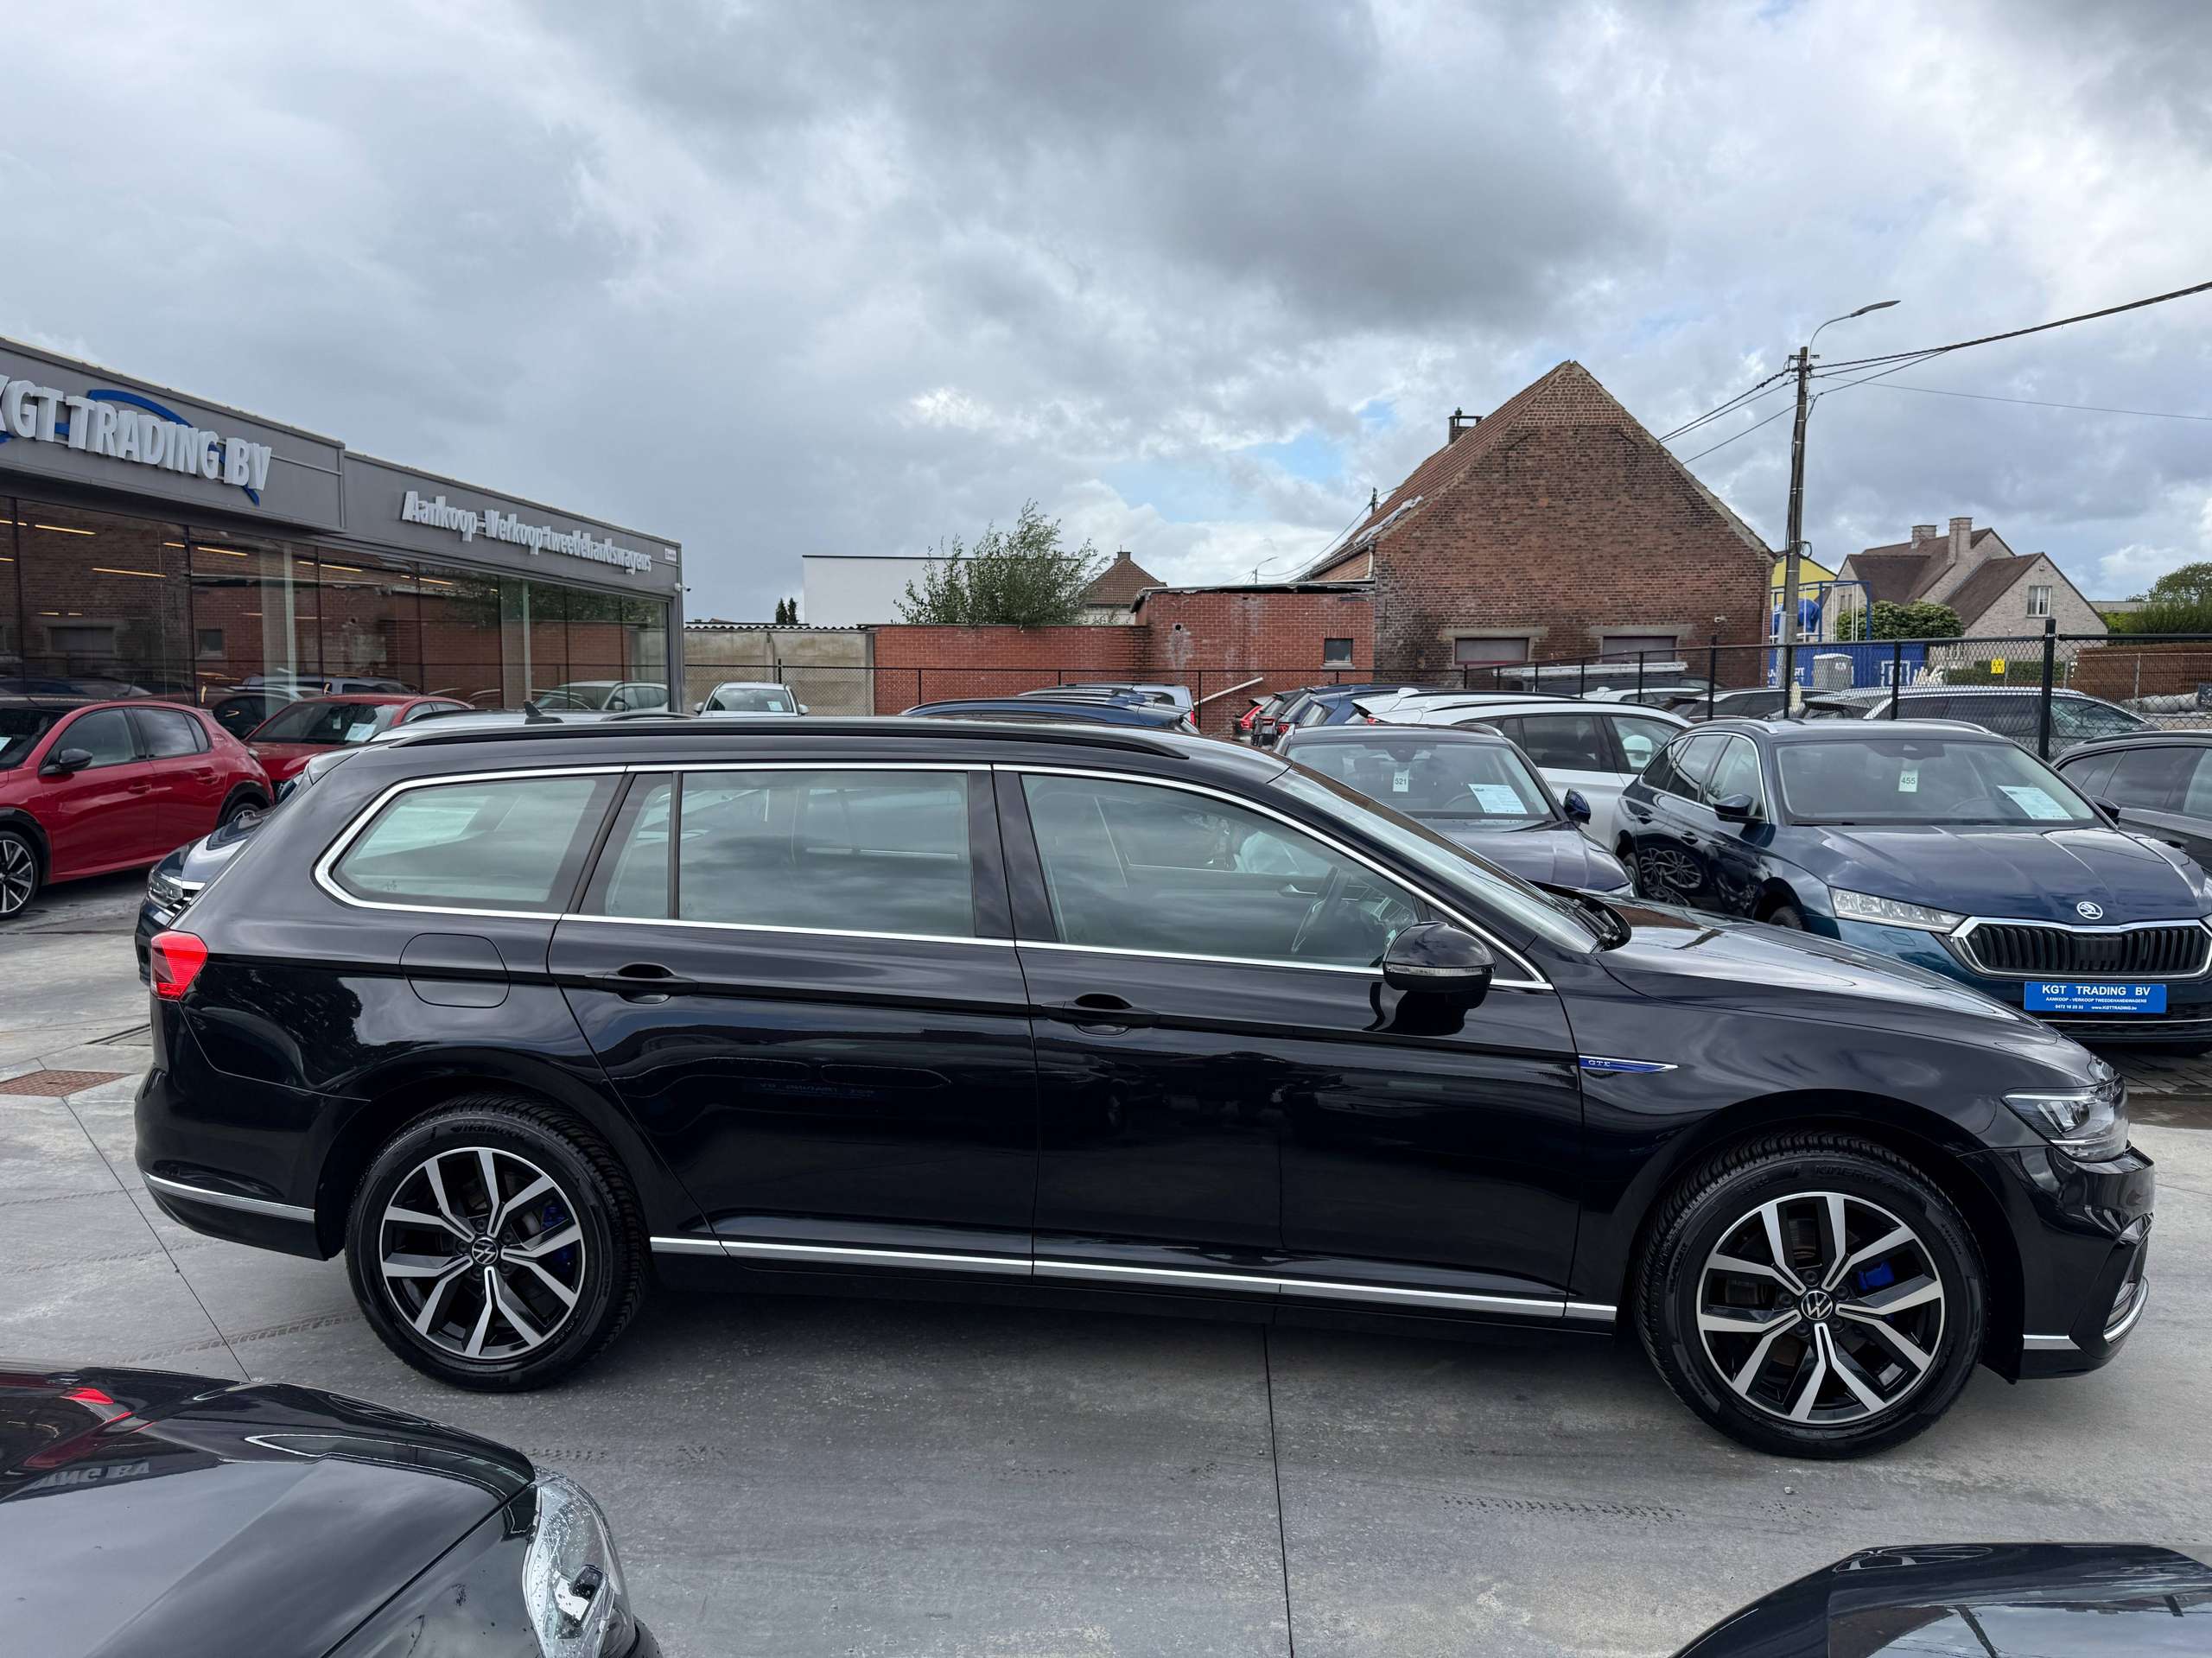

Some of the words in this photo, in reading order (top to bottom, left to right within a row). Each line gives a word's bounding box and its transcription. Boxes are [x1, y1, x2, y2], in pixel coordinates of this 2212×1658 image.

[67, 396, 220, 480] TRADING
[224, 437, 273, 492] BV
[2042, 985, 2067, 994] KGT
[2075, 986, 2126, 995] TRADING
[2135, 988, 2151, 996] BV
